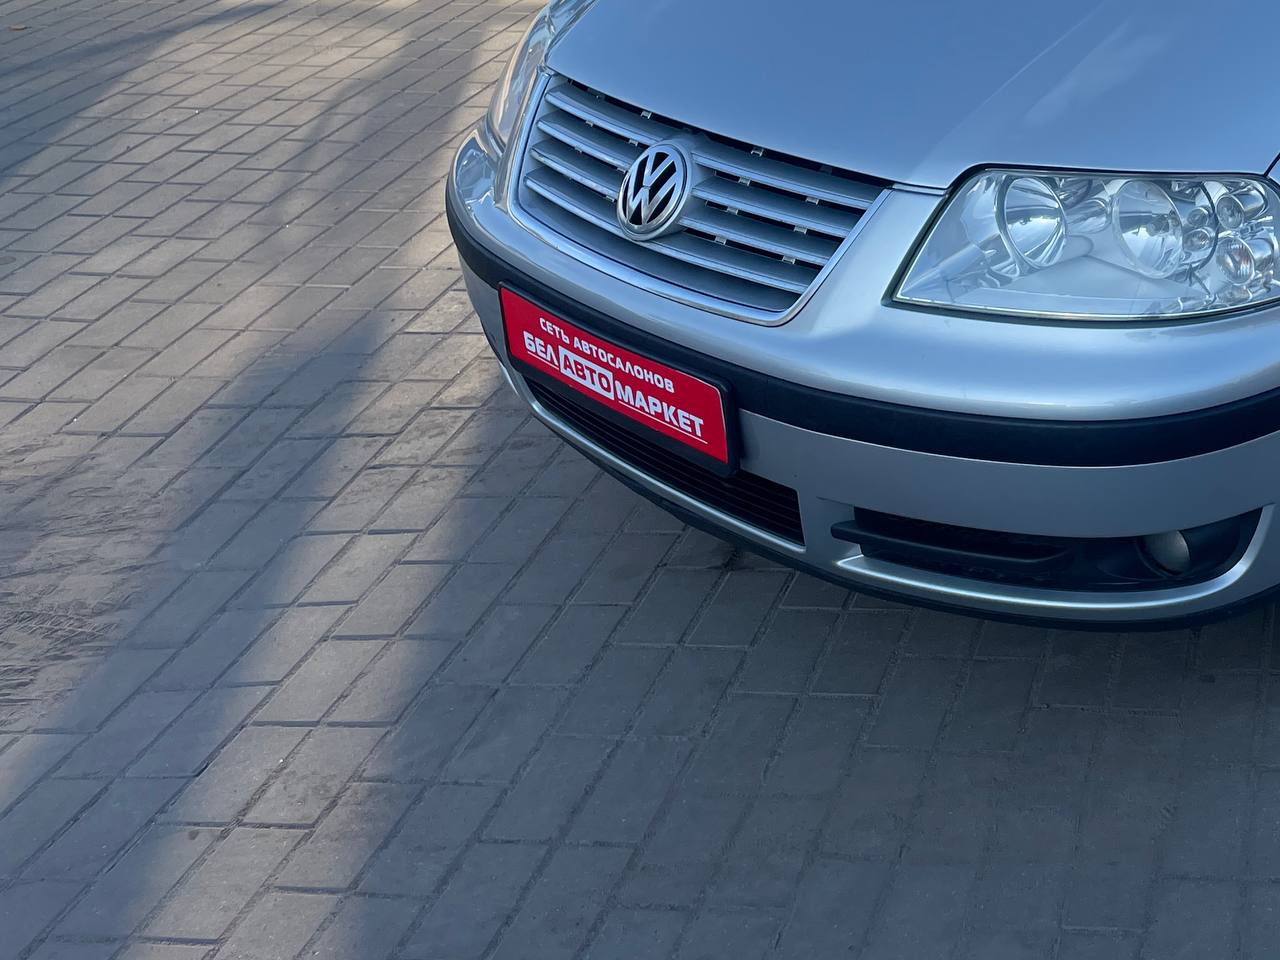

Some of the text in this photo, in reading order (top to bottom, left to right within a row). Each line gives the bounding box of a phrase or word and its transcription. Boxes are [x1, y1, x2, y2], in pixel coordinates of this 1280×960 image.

[523, 330, 705, 438] БЕЛ АВТО МАРКЕТ
[539, 317, 675, 394] СЕТЬ АВТОСАЛОНОВ
